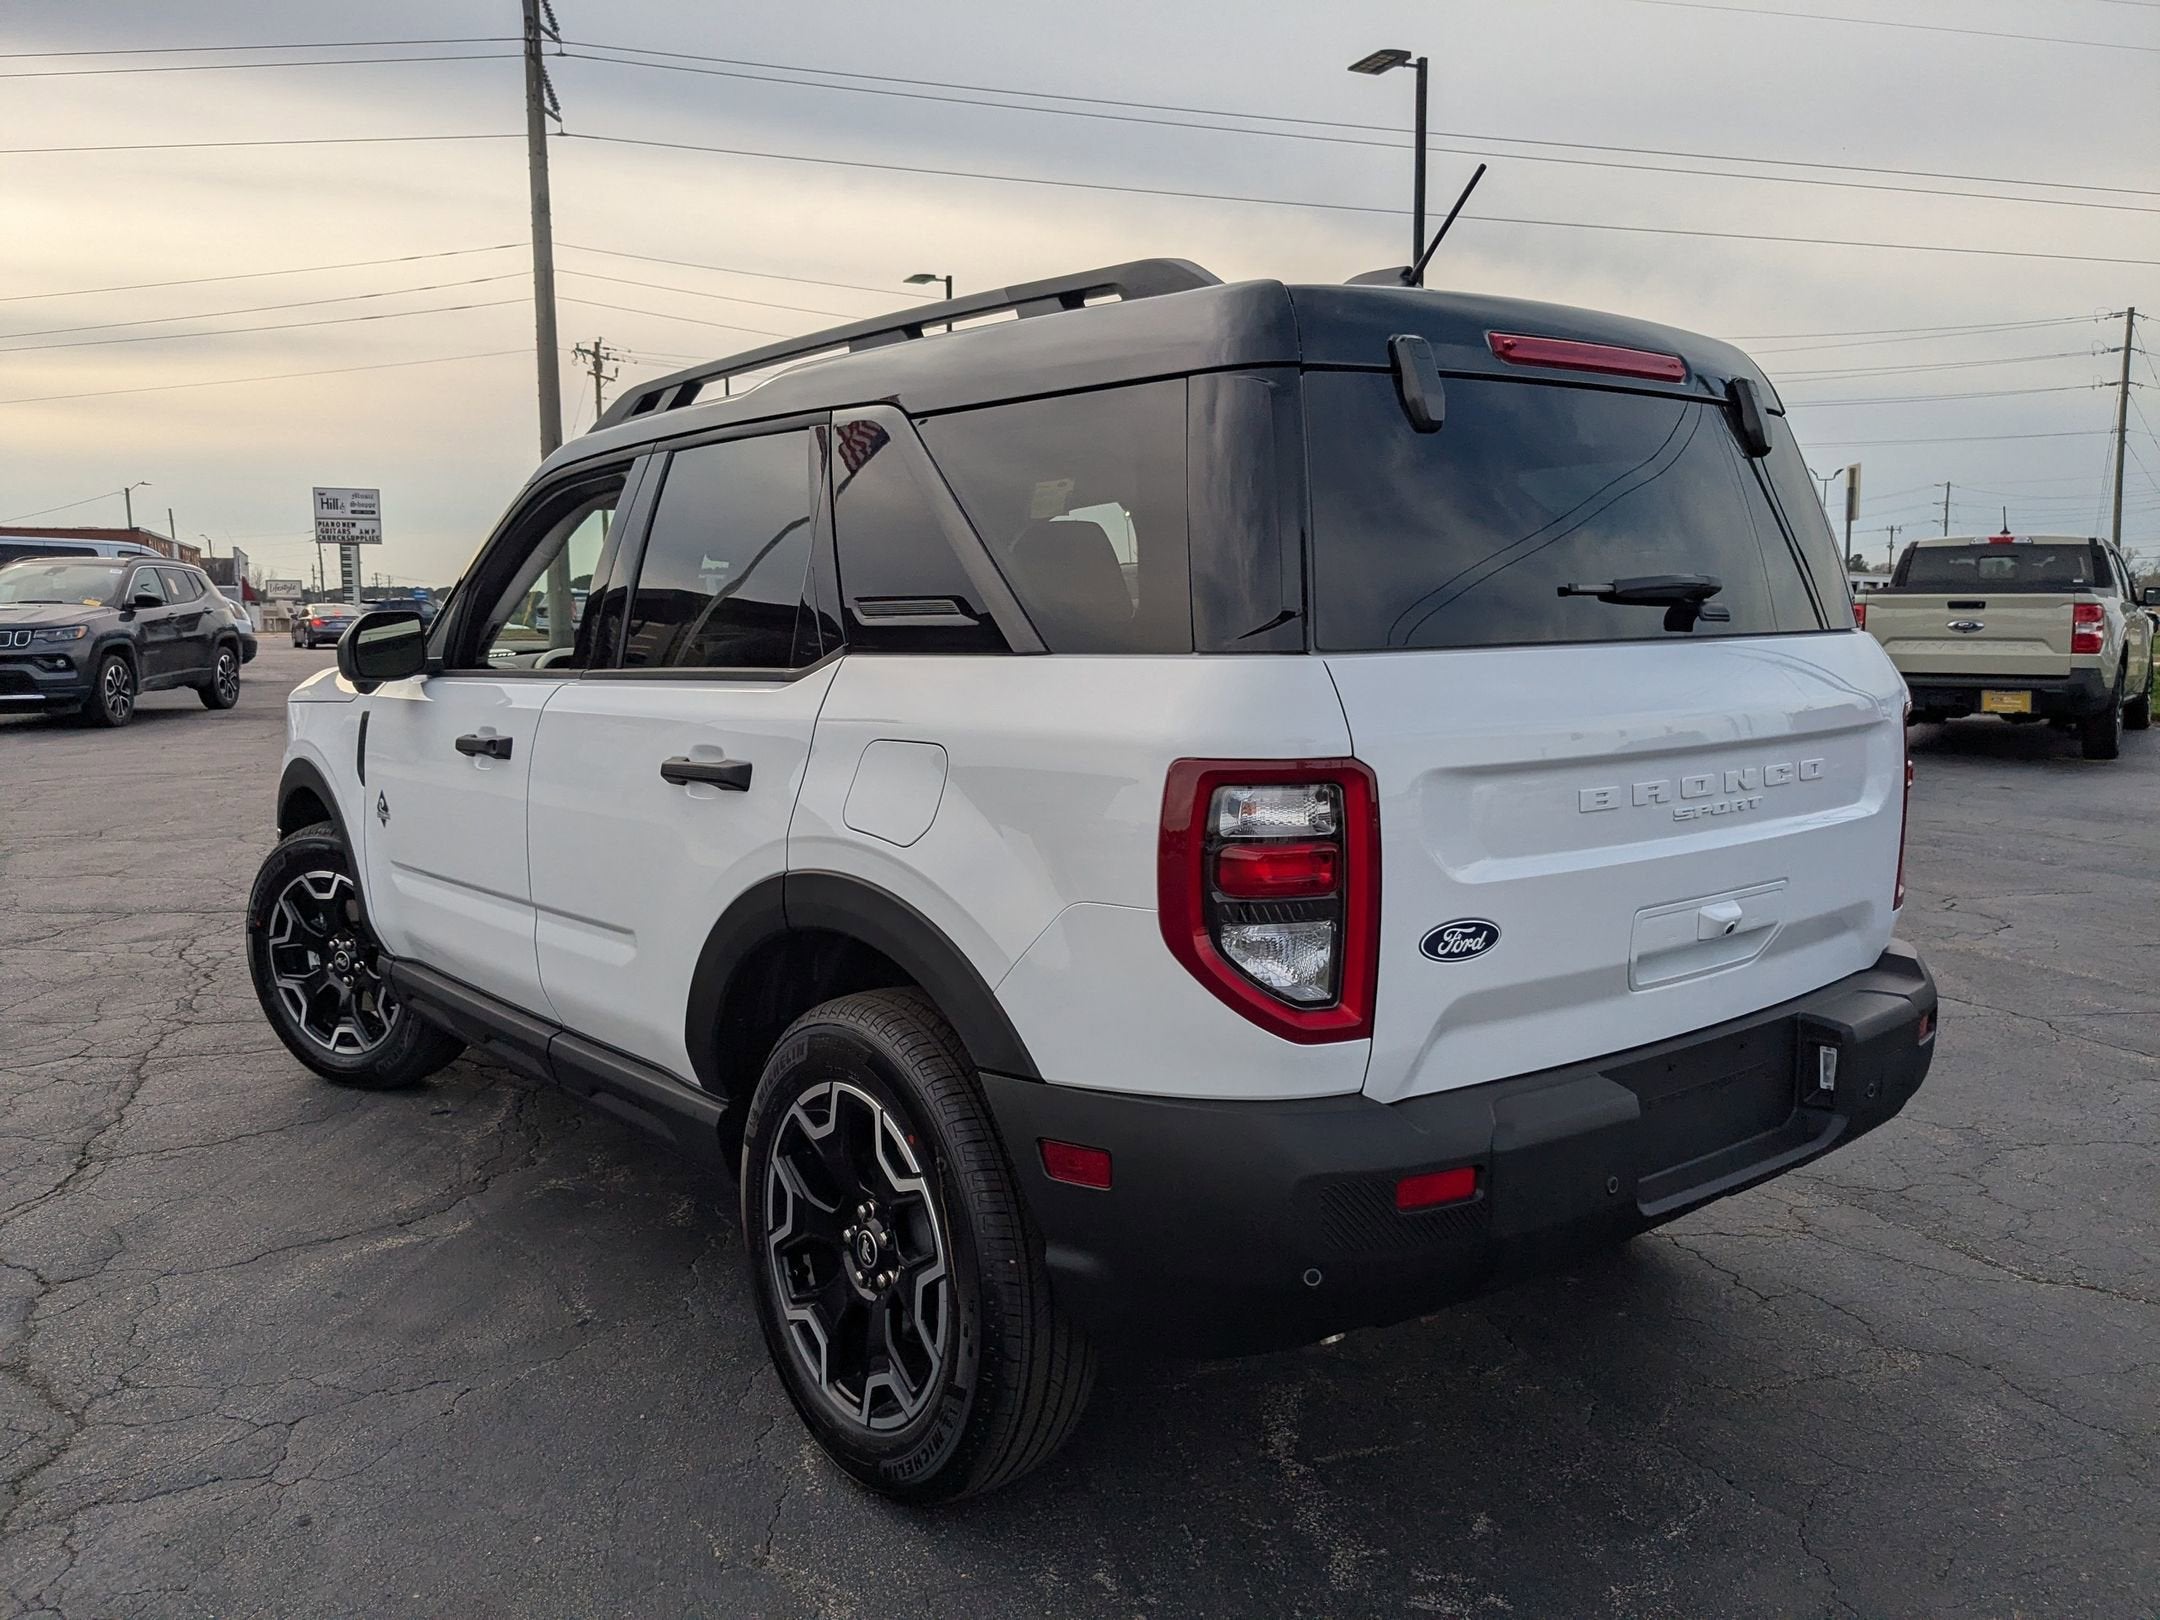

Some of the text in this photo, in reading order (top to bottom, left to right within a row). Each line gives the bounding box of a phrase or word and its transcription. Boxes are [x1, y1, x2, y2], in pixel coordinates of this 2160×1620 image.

[320, 498, 339, 510] Hill
[320, 527, 376, 536] GUITARS AMP
[1578, 757, 1825, 814] BRONCO
[1672, 796, 1764, 822] SPORT
[1437, 926, 1488, 955] Ford
